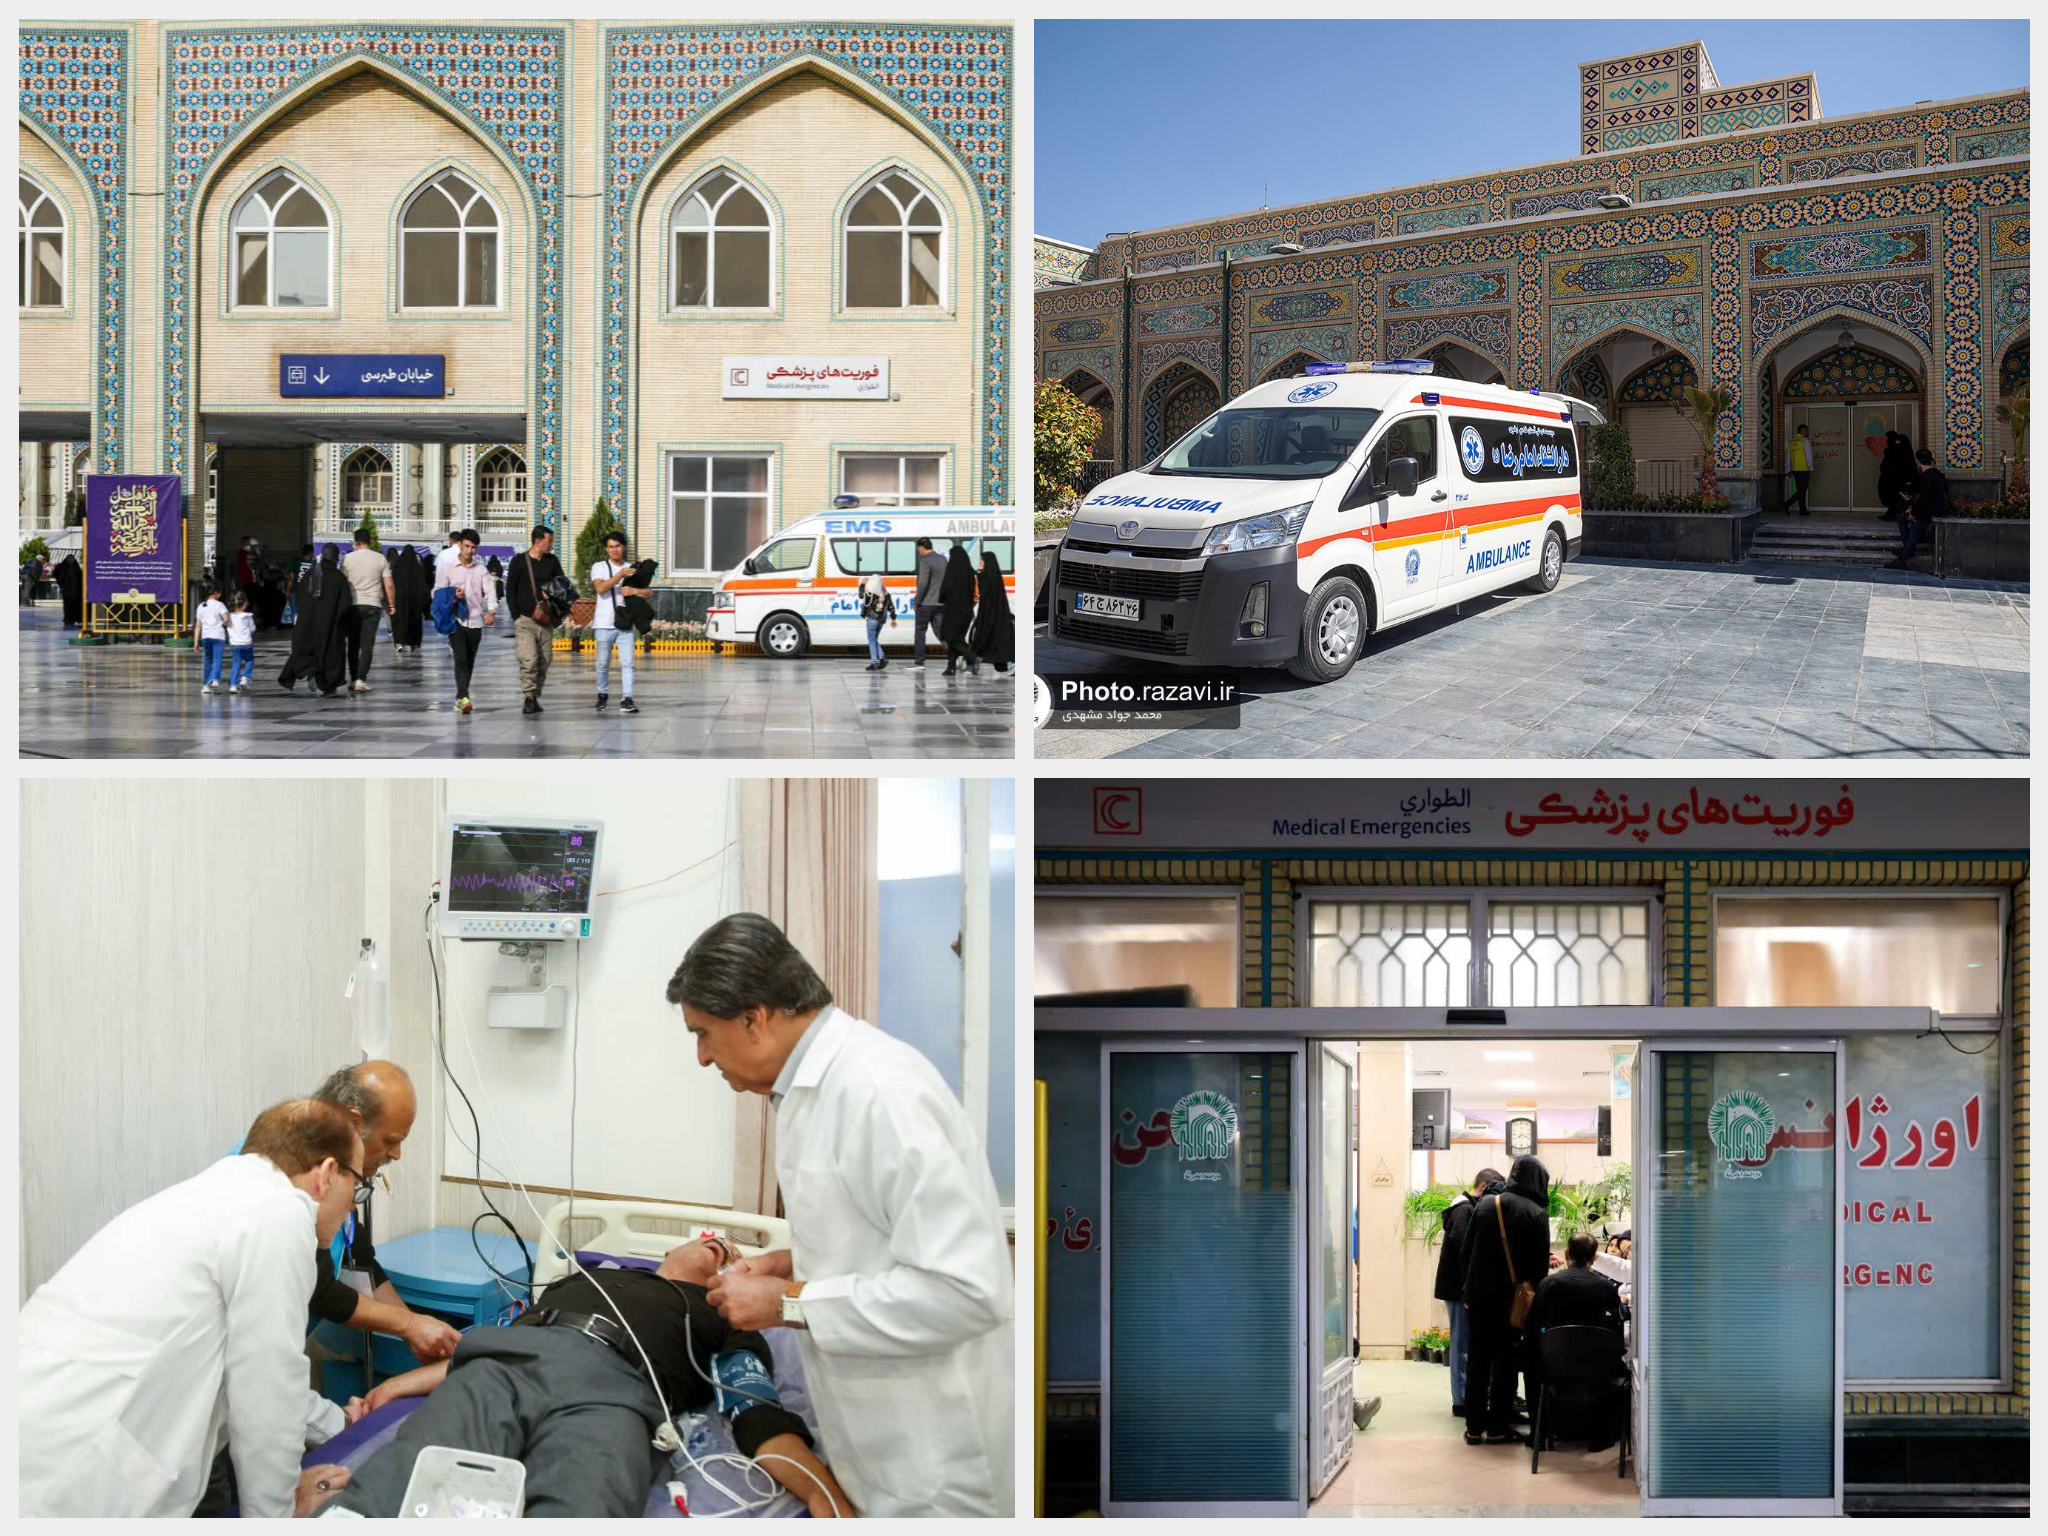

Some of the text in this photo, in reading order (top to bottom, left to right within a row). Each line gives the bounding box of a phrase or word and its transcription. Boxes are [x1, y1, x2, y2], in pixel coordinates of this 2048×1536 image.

[361, 367, 434, 383] خیابان طبرسی
[766, 365, 815, 382] پزشکی
[1501, 442, 1519, 475] رضا
[825, 520, 892, 534] EMS
[1466, 539, 1531, 574] AMBULANCE
[1505, 787, 1651, 844] پزشکی
[1272, 817, 1472, 839] Medical Emergencies
